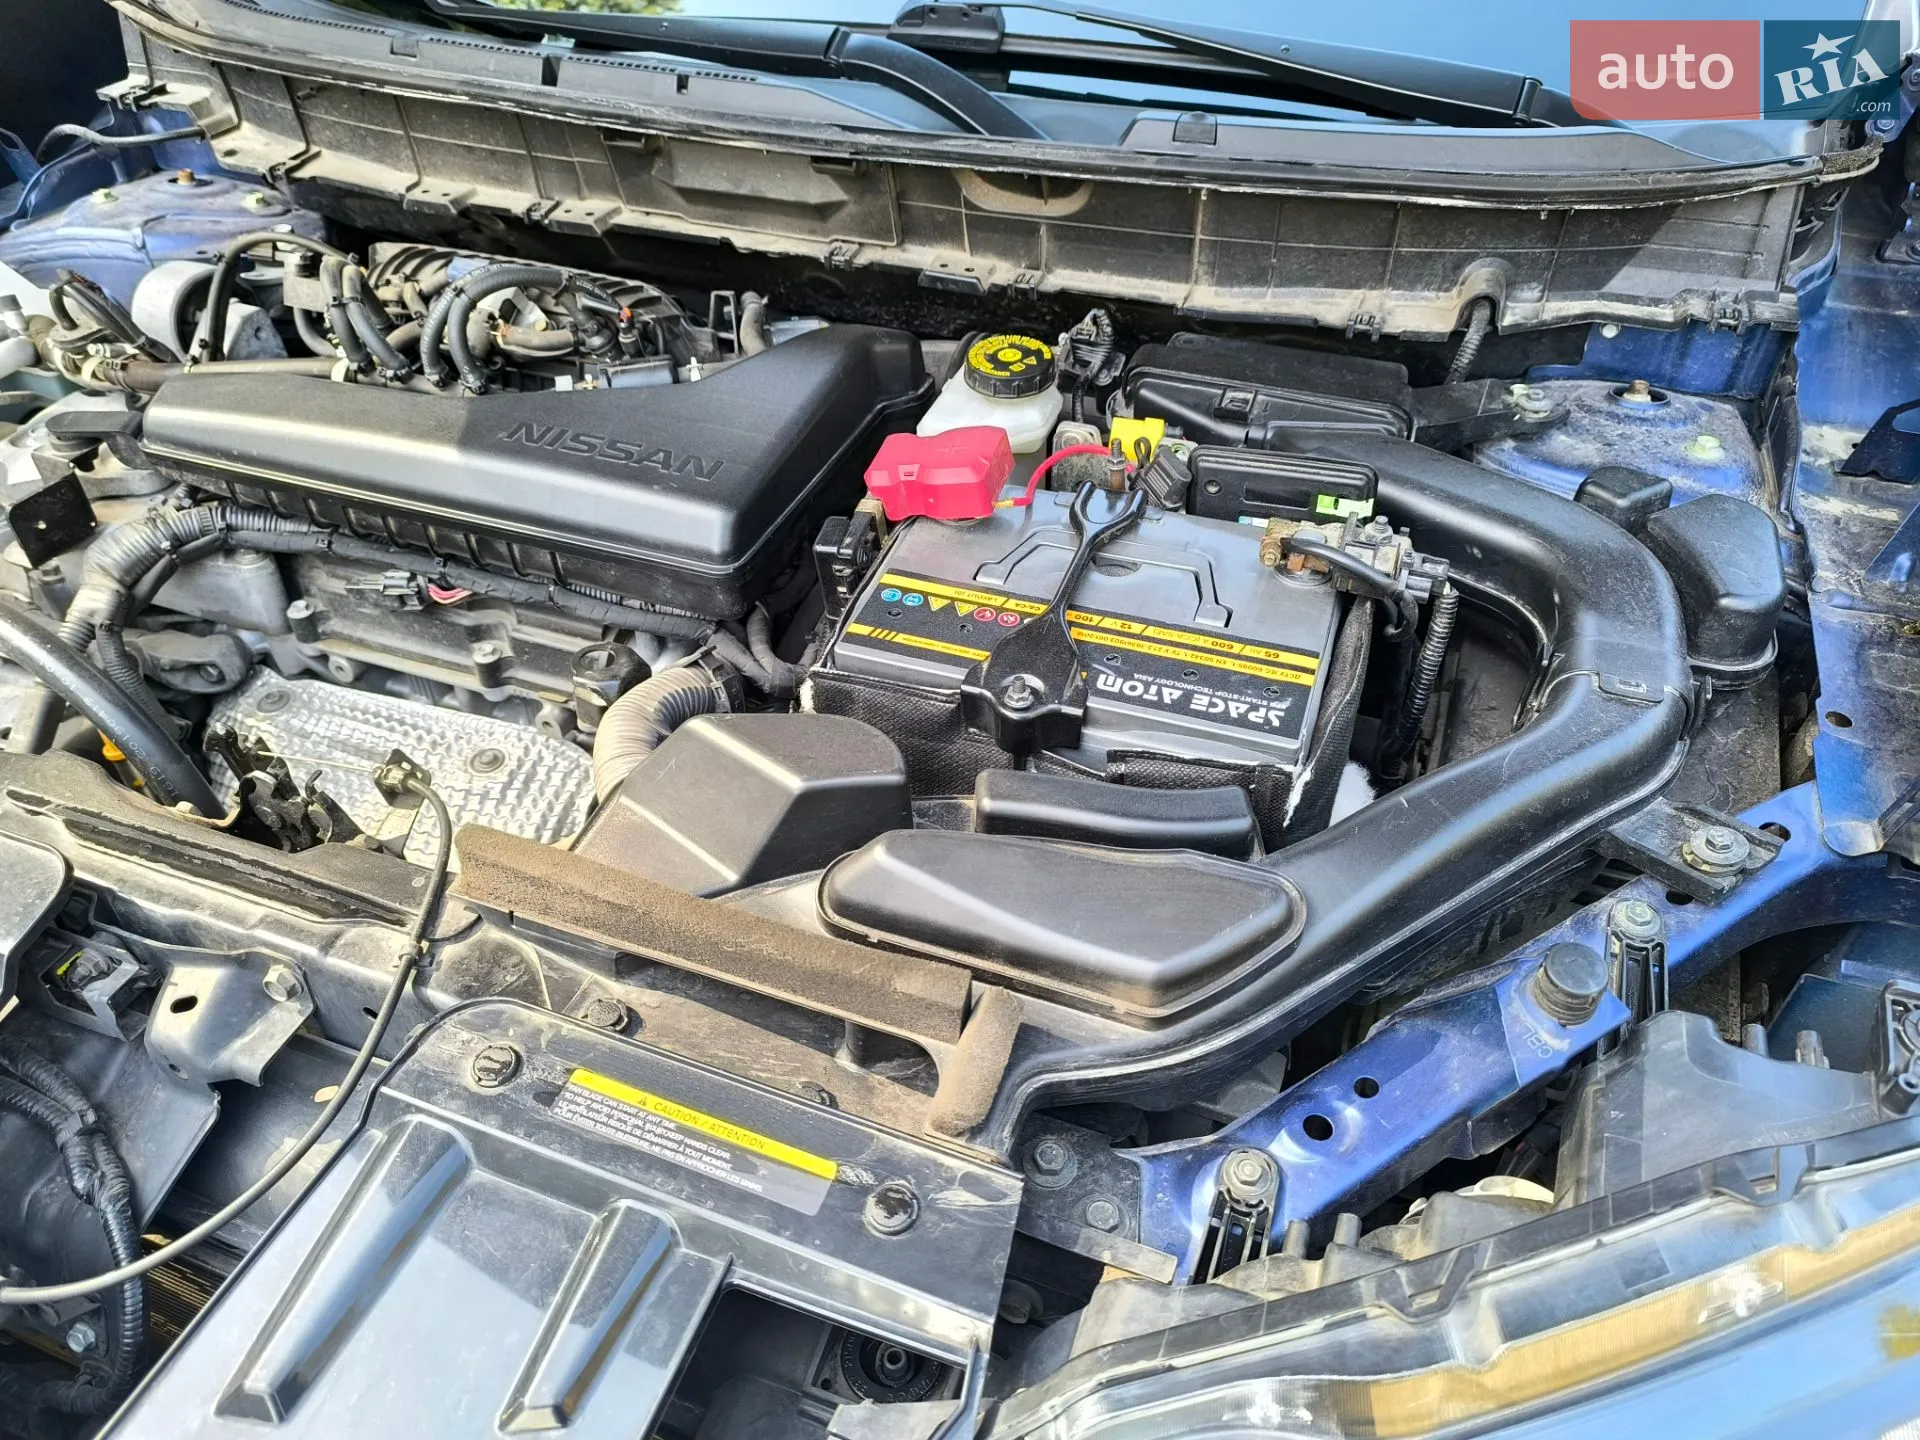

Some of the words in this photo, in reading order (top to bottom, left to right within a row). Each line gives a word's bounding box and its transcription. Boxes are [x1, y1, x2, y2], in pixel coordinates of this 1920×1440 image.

[501, 421, 725, 482] NISSAN
[1074, 614, 1094, 622] 100
[1210, 640, 1234, 650] 600
[1264, 650, 1279, 659] 65
[1132, 672, 1153, 681] ASIA
[1095, 672, 1183, 705] ATOM
[1155, 677, 1213, 693] TECHNOLOGY
[1214, 689, 1267, 705] START-STOP
[1189, 692, 1284, 727] SPACE
[646, 1114, 661, 1123] ANY
[652, 1101, 699, 1126] CAUTION
[707, 1122, 766, 1149] ATTENTION
[631, 1128, 643, 1136] DE
[684, 1148, 701, 1158] TOUT
